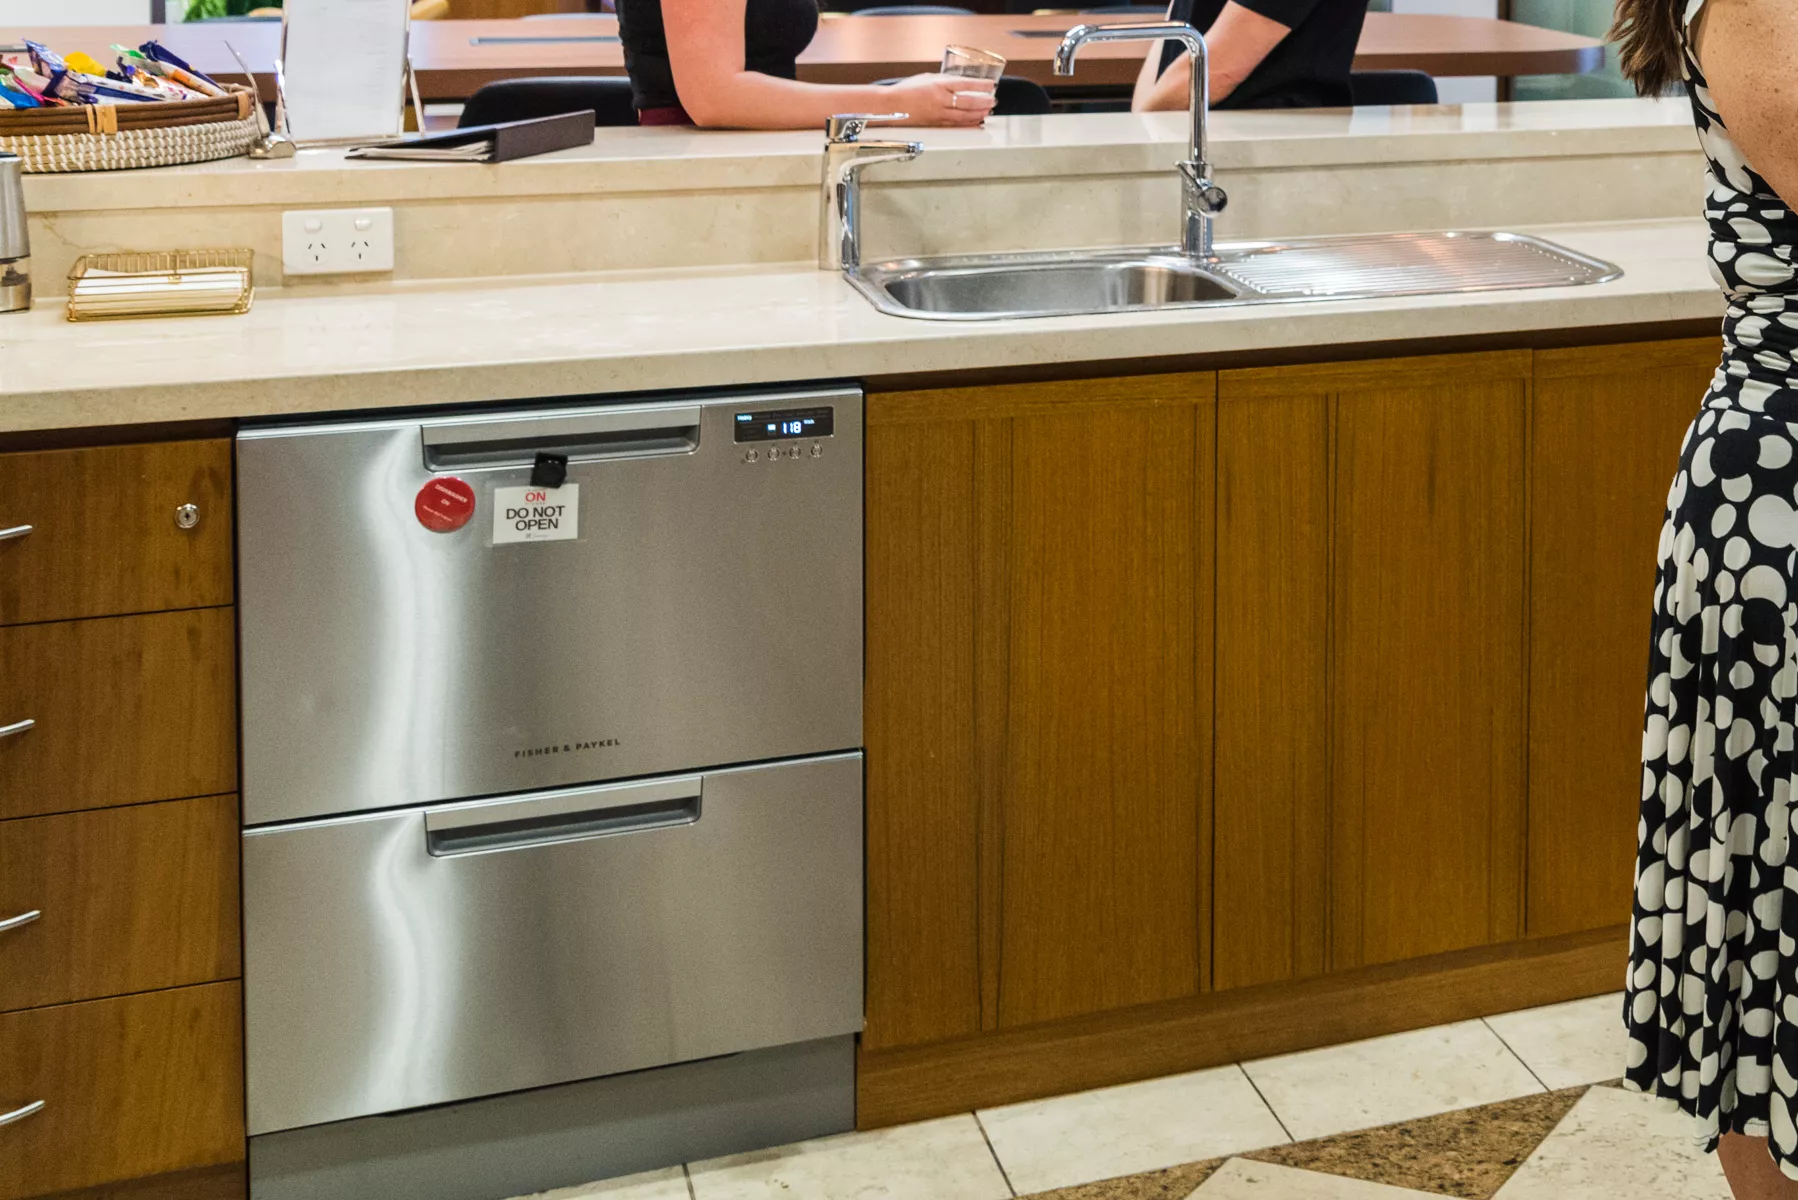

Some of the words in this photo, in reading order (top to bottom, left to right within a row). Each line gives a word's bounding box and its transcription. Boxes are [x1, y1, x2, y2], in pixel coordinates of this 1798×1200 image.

[525, 491, 546, 502] ON
[506, 507, 529, 520] DO
[532, 505, 566, 518] NOT
[515, 518, 559, 531] OPEN
[514, 746, 559, 758] FISHER
[563, 744, 570, 752] &
[575, 739, 620, 751] PAYKEL
